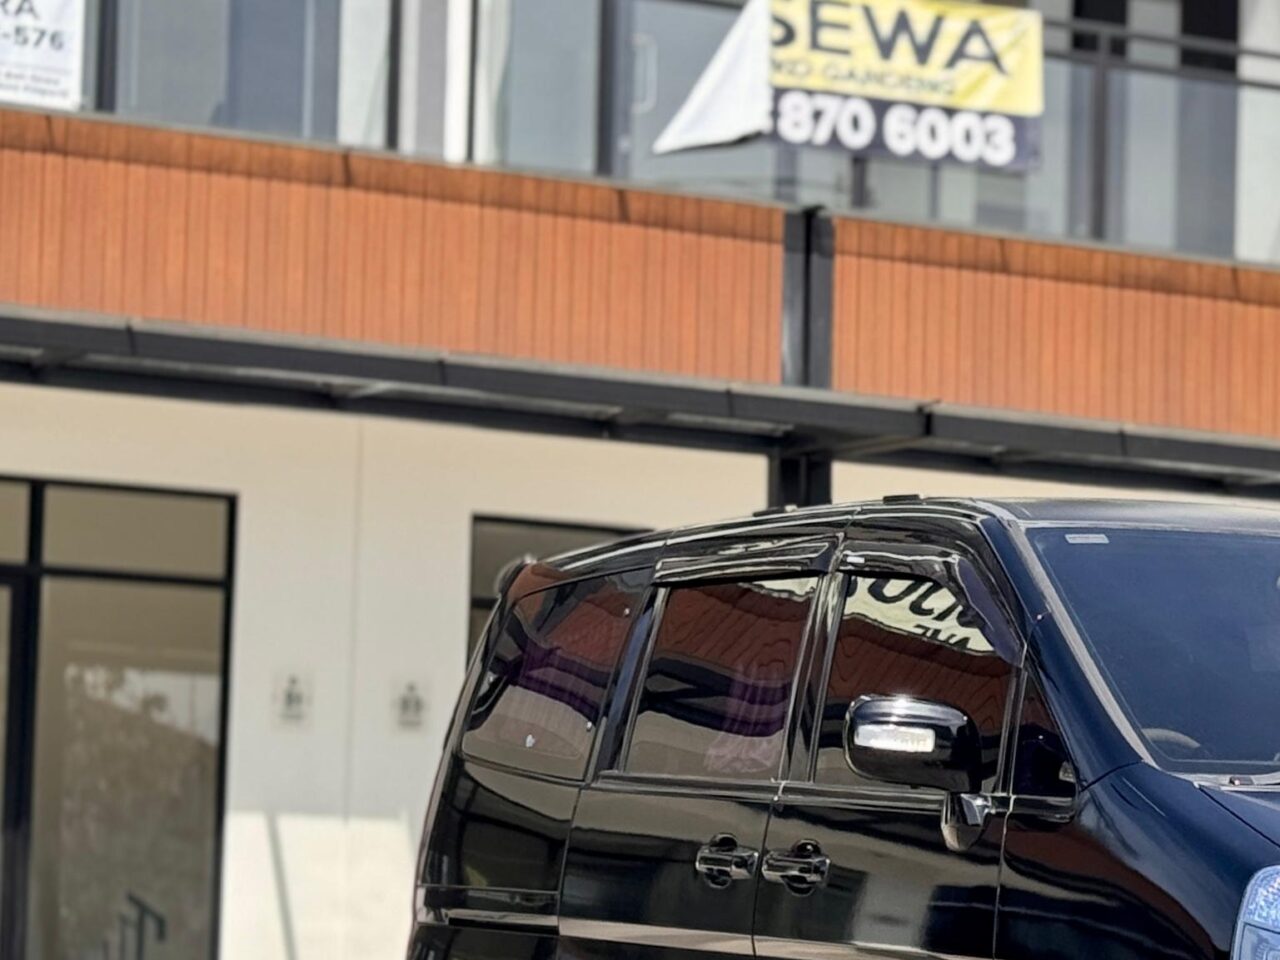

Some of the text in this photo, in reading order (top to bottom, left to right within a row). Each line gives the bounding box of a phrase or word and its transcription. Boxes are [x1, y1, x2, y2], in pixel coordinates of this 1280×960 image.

[0, 26, 64, 51] -576
[777, 90, 1016, 167] 870 6003
